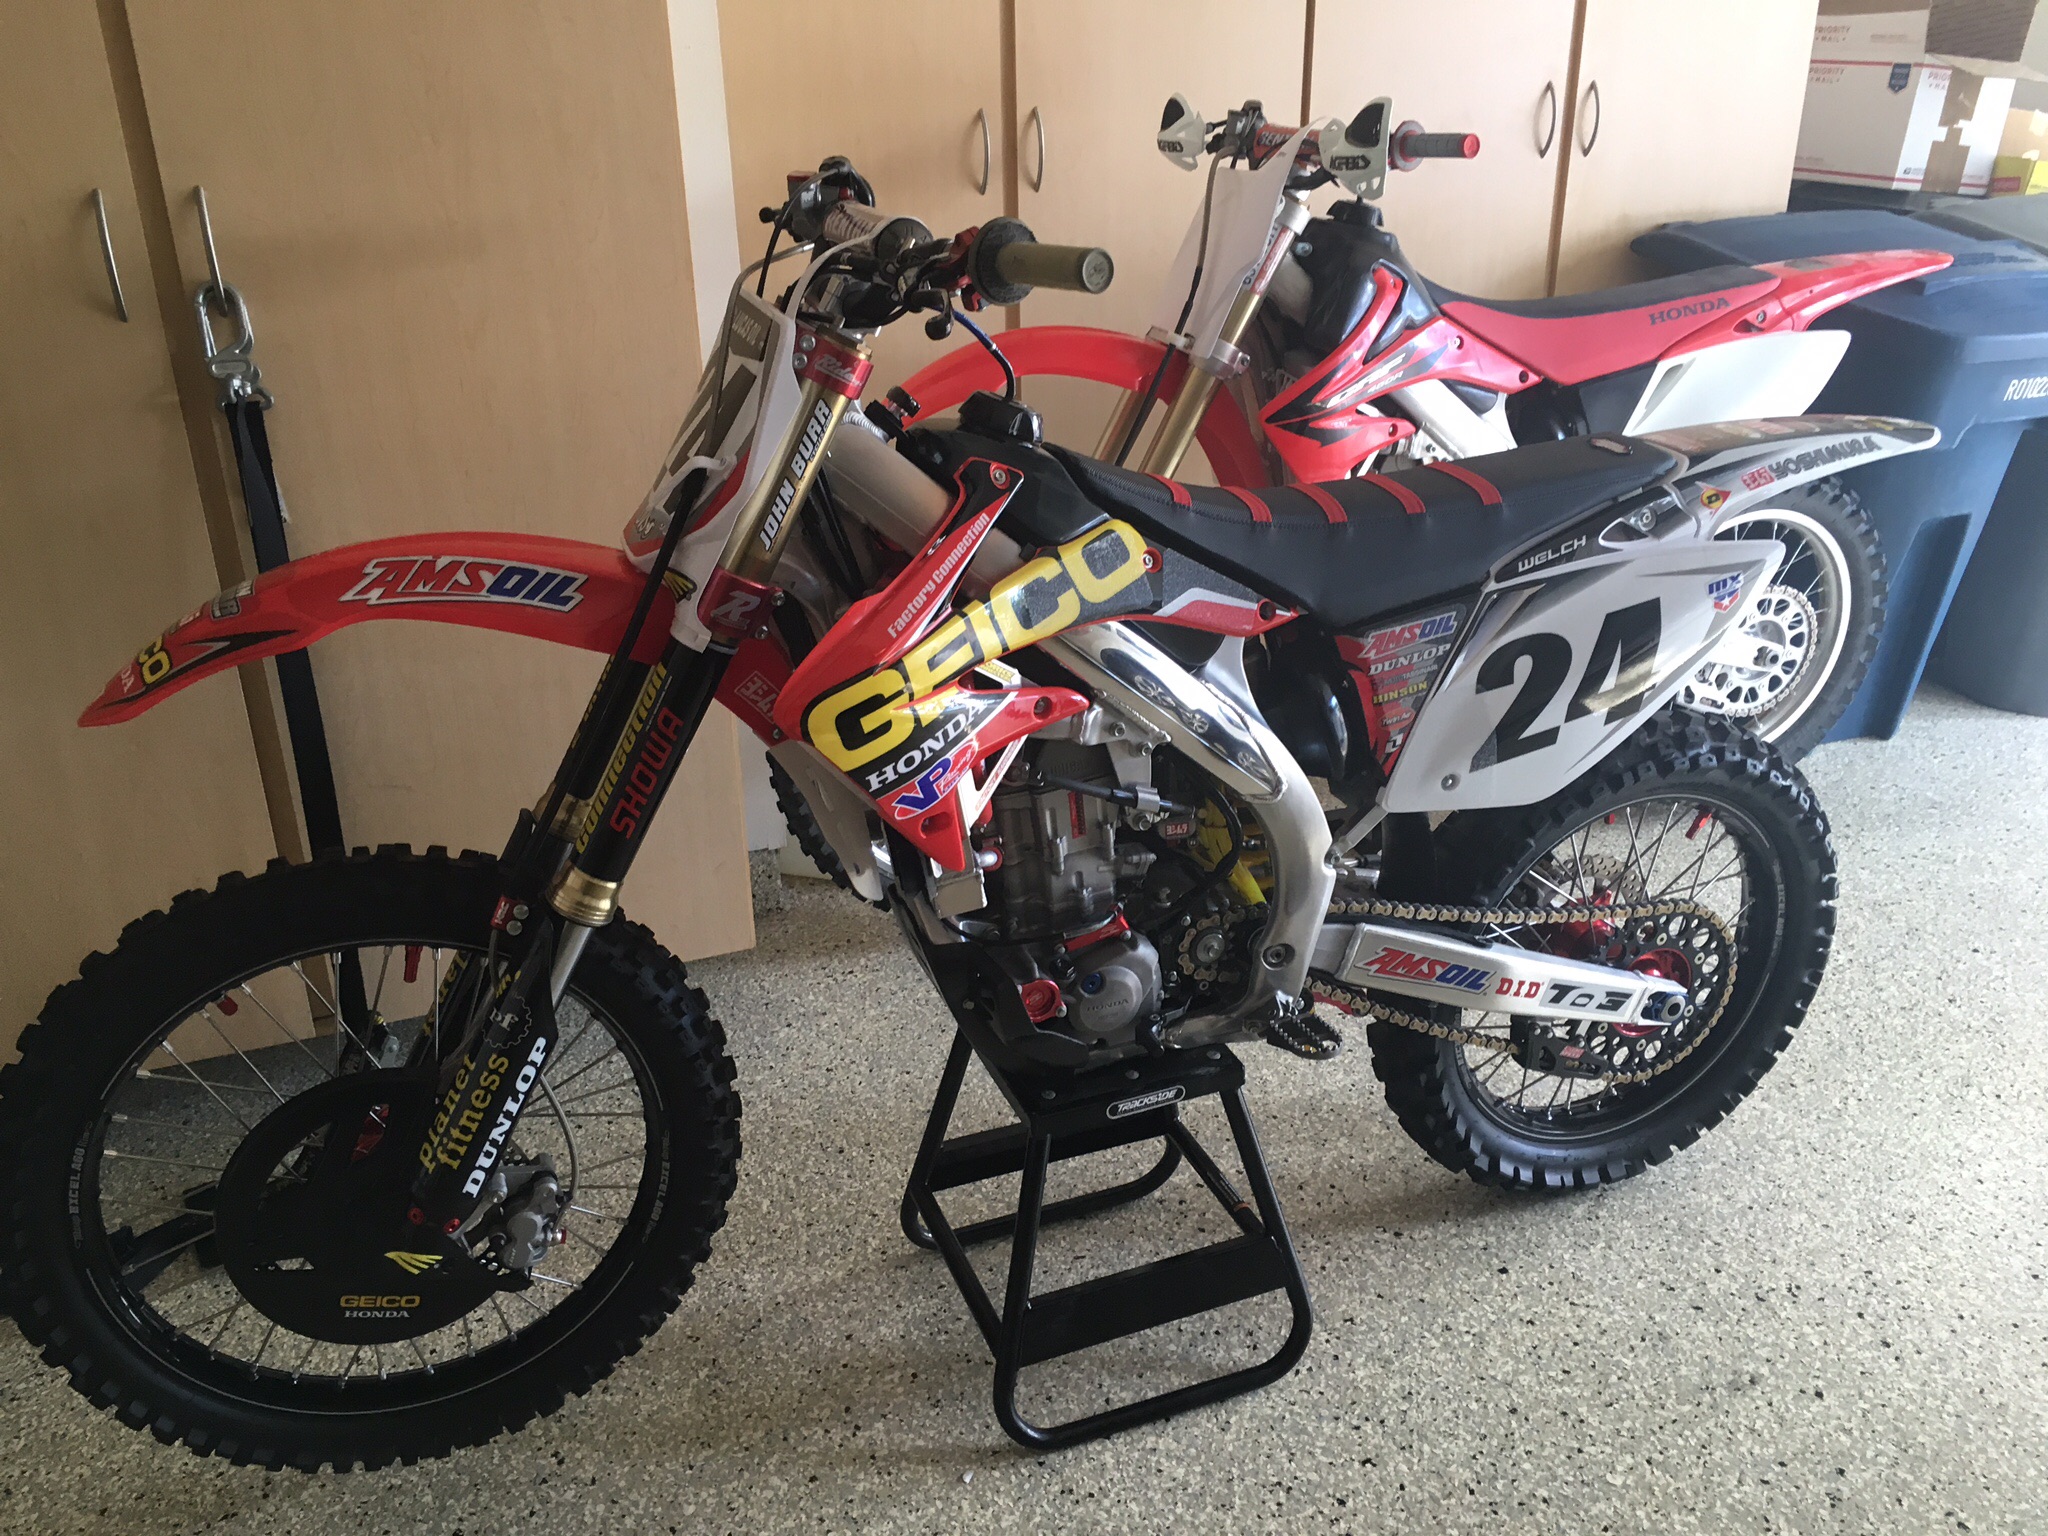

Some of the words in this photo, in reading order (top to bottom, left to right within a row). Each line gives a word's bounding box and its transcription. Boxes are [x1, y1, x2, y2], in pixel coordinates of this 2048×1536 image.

[1649, 297, 1731, 326] HONDA
[758, 478, 795, 551] JOHN
[790, 398, 833, 481] BURR
[1767, 435, 1883, 481] YOSHIMURA
[886, 579, 937, 639] Factory
[932, 512, 990, 585] Connection
[1518, 534, 1587, 572] WELCH
[342, 556, 586, 611] AMSOIL
[807, 518, 1149, 773] GEICO
[1359, 612, 1457, 659] AMSOIL
[1368, 643, 1452, 677] DUNLOP
[1373, 681, 1428, 705] HINSON
[1469, 597, 1661, 774] 24
[865, 700, 989, 793] HONDA
[609, 707, 685, 840] SHOWA
[891, 755, 954, 812] VP
[1361, 947, 1494, 993] AMSOIL
[1495, 976, 1542, 999] D.I.D
[1086, 997, 1130, 1012] HONDA
[418, 1053, 478, 1175] planet
[436, 1052, 510, 1171] fitness
[461, 1035, 548, 1199] DUNLOP
[1116, 1088, 1178, 1113] TRACKSIDE
[68, 1172, 80, 1215] EXCEL
[339, 1294, 421, 1310] GEICO
[343, 1309, 411, 1319] HONDA
